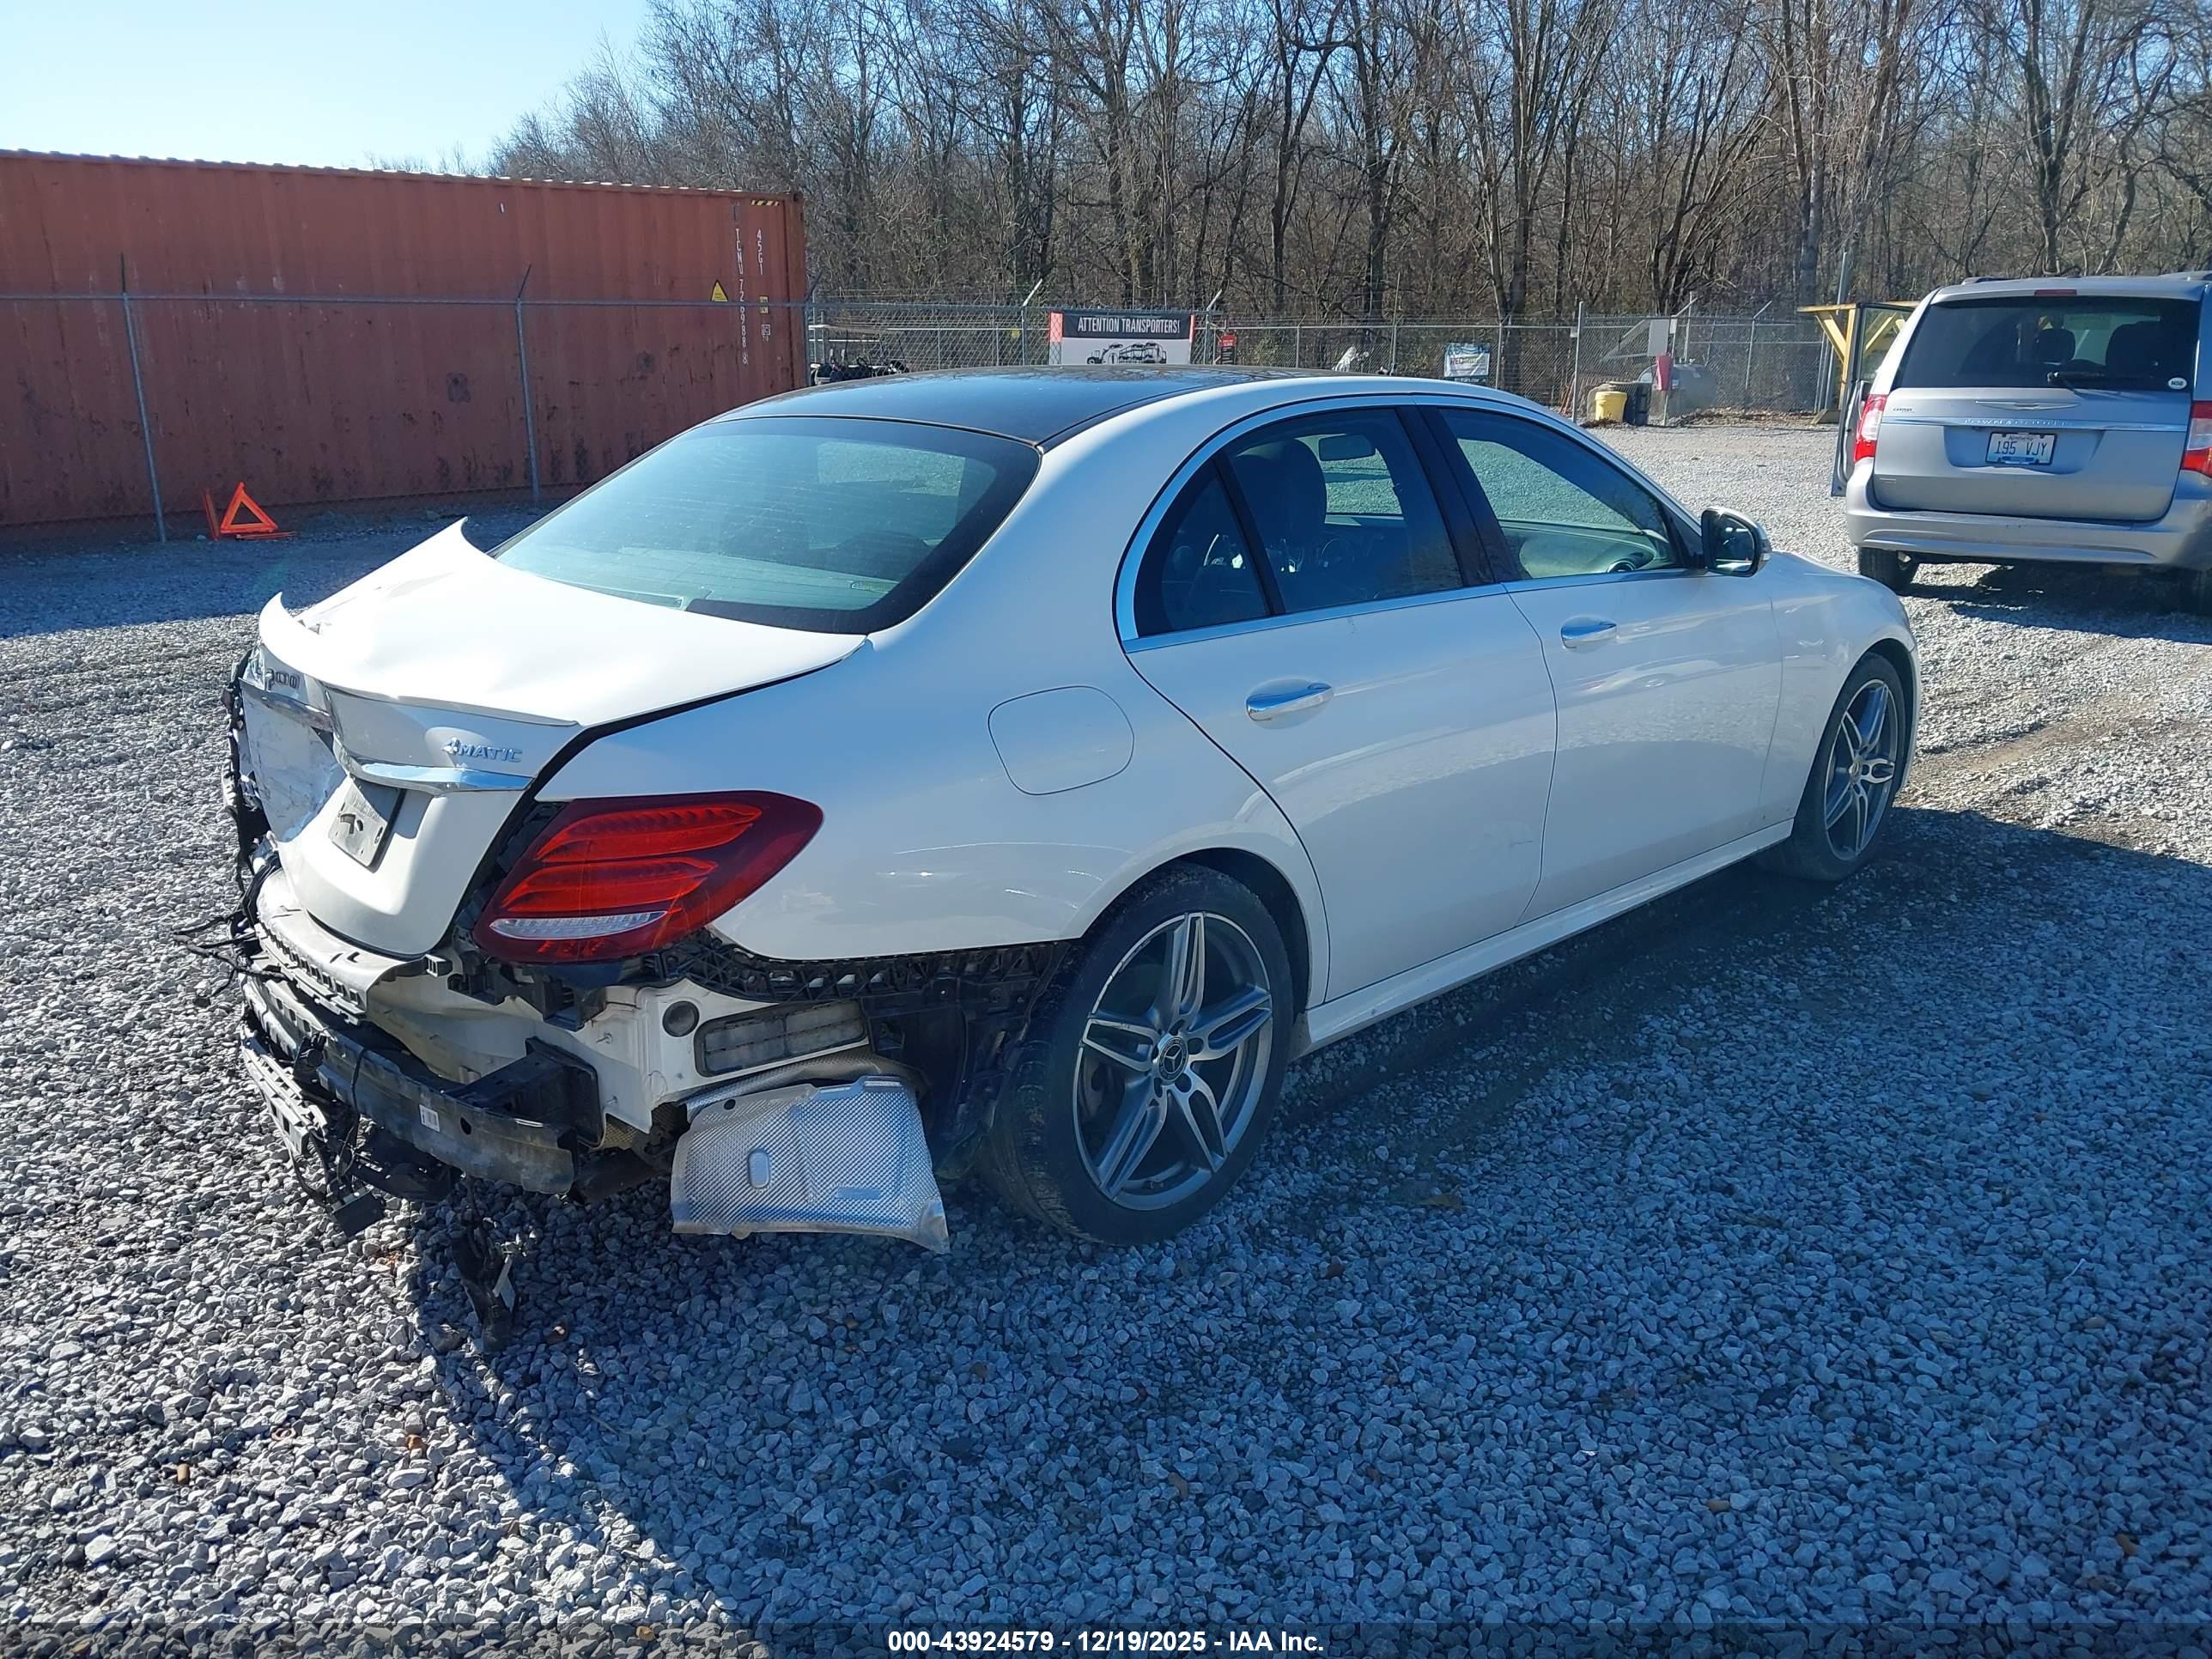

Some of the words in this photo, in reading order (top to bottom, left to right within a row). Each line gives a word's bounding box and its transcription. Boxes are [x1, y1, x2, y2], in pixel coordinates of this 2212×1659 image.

[1078, 317, 1119, 332] ATTENTION
[1121, 317, 1181, 334] TRANSPORTERS!
[1994, 441, 2017, 455] 195
[2026, 441, 2047, 456] VJY
[442, 737, 522, 763] 4MATIC
